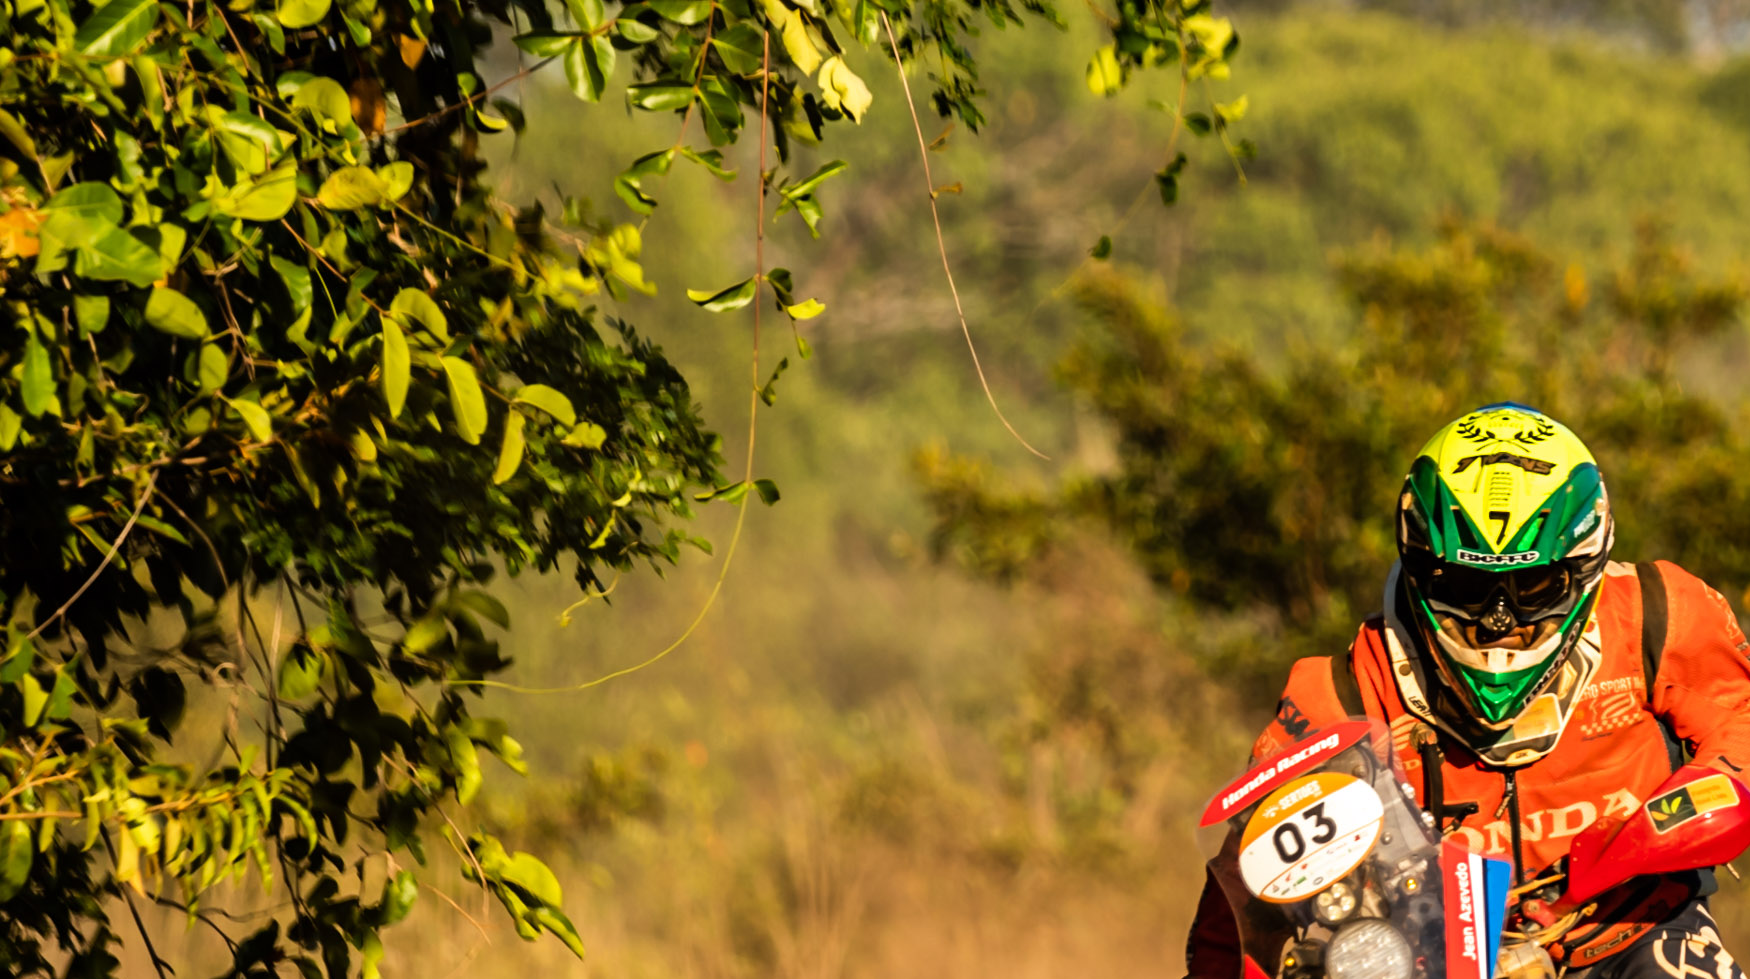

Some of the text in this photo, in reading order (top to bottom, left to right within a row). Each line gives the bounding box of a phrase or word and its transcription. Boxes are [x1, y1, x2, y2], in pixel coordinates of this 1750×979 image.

[1488, 510, 1511, 546] 7
[1600, 677, 1632, 696] SPORT
[1222, 733, 1339, 810] Honda Racing
[1272, 801, 1337, 864] 03
[1441, 787, 1643, 855] ONDA
[1455, 862, 1477, 961] Jean Azevedo
